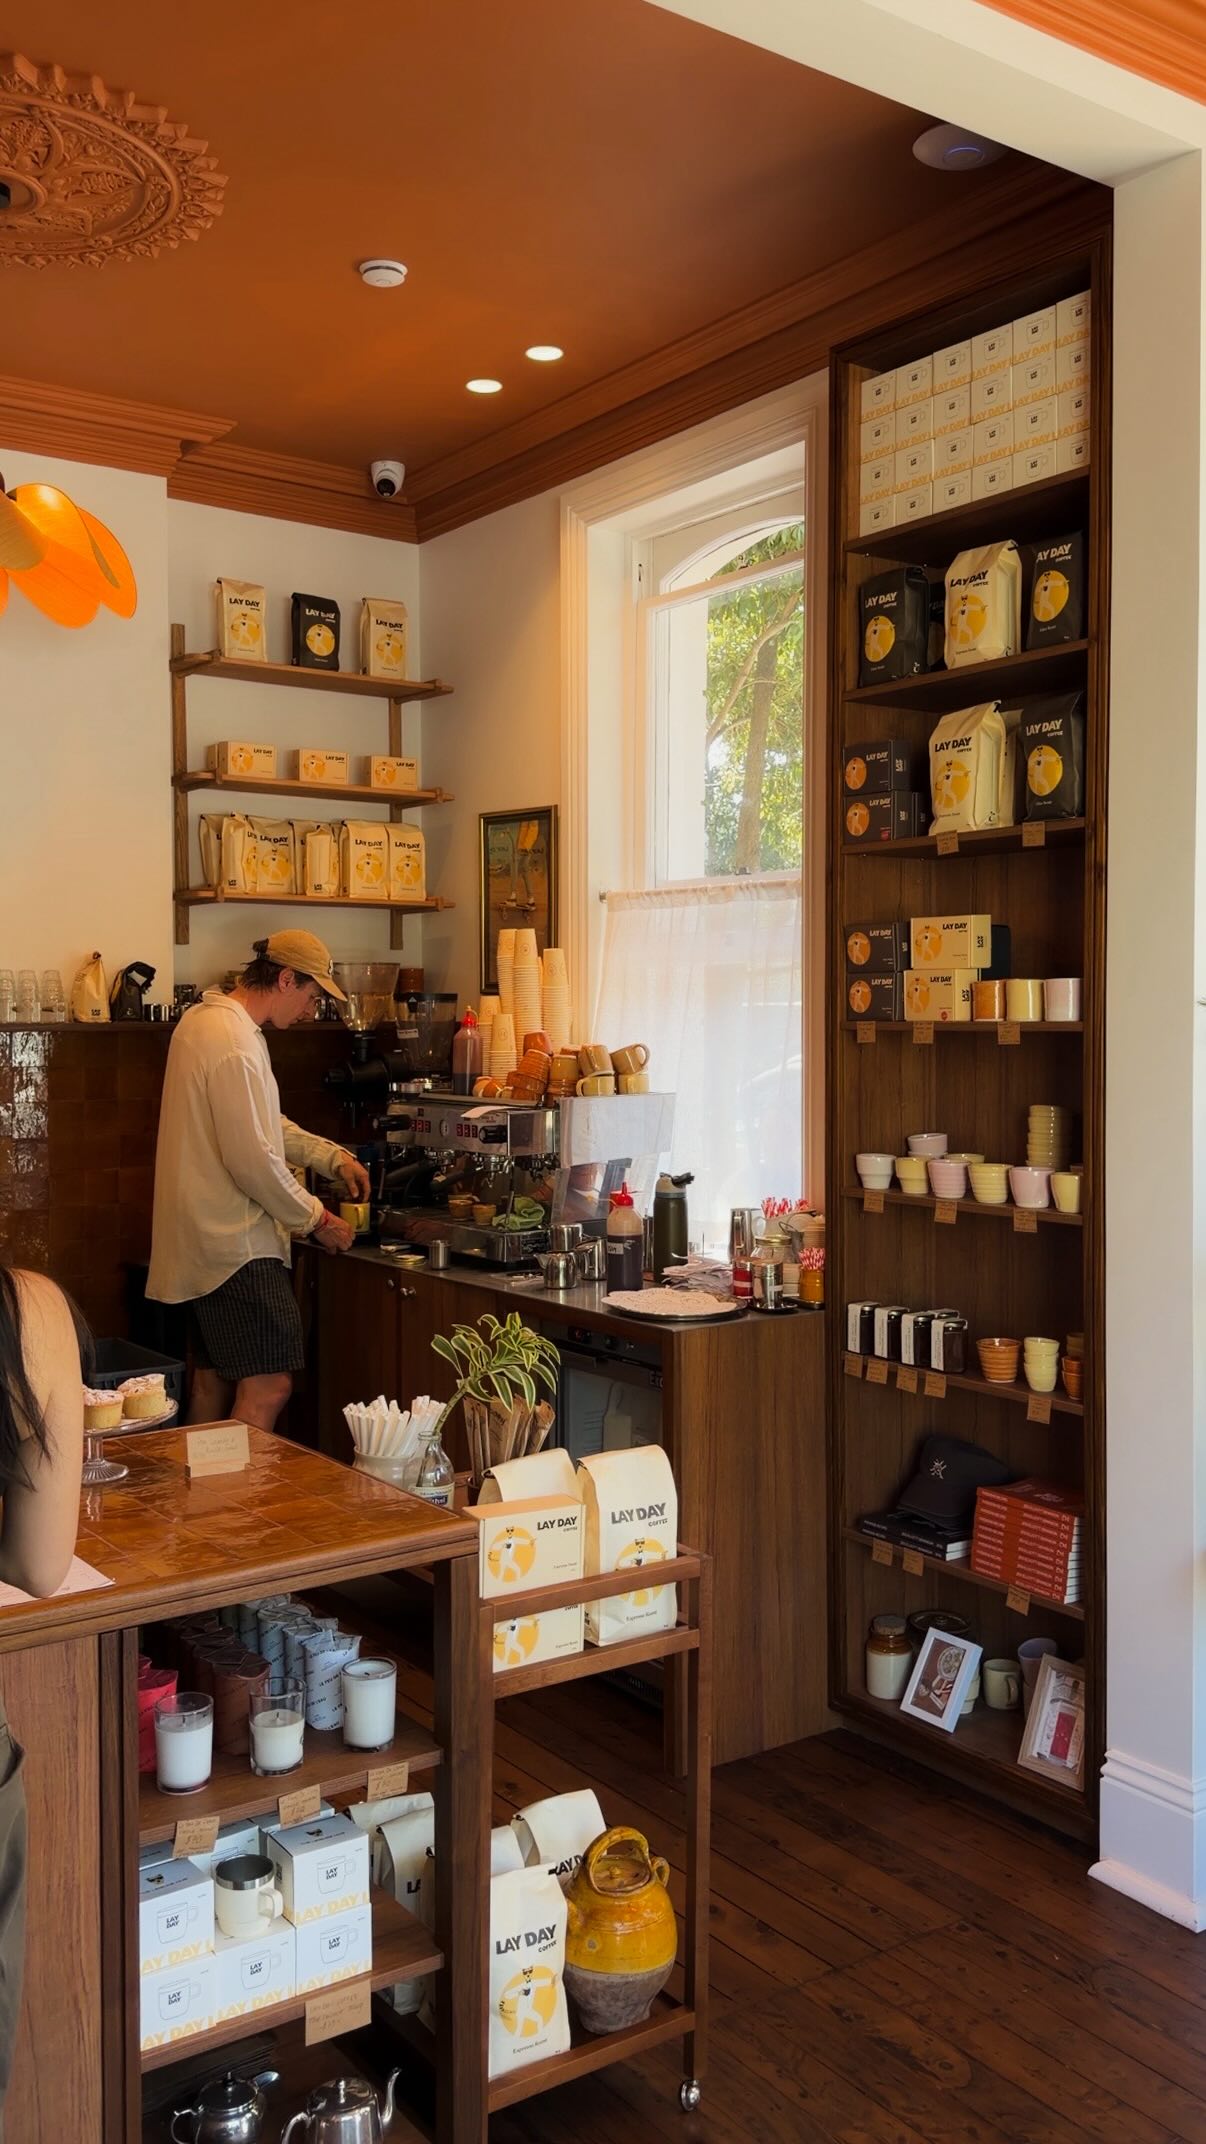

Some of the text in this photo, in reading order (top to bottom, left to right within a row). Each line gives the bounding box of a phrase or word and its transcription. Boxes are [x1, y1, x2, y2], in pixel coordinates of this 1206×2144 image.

[1050, 543, 1072, 557] DAY
[950, 569, 989, 588] LAY DAY
[879, 592, 898, 604] DAY
[244, 599, 260, 607] DAY
[305, 608, 320, 616] LAY
[375, 619, 388, 627] LAY
[1026, 719, 1063, 736] LAY DAY
[935, 736, 972, 753] LAY DAY
[260, 834, 288, 844] LAY DAY
[395, 841, 407, 849] LAY
[611, 1502, 666, 1524] LAY DAY
[537, 1516, 578, 1531] LAY DAY
[648, 1518, 668, 1527] COFFEE
[326, 1867, 338, 1875] LAY
[326, 1872, 338, 1880] DAY
[327, 1895, 358, 1914] DAY
[166, 1914, 180, 1923] LAY
[166, 1920, 180, 1929] DAY
[328, 1936, 341, 1945] LAY
[496, 1924, 557, 1956] LAY DAY
[328, 1942, 341, 1950] DAY
[538, 1940, 557, 1953] COFFEE
[168, 1941, 200, 1963] DAY
[250, 1961, 263, 1970] LAY
[250, 1967, 263, 1975] DAY
[168, 1991, 181, 2000] LAY
[252, 1989, 281, 2008] DAY
[168, 1997, 181, 2005] DAY
[169, 2017, 205, 2040] DAY
